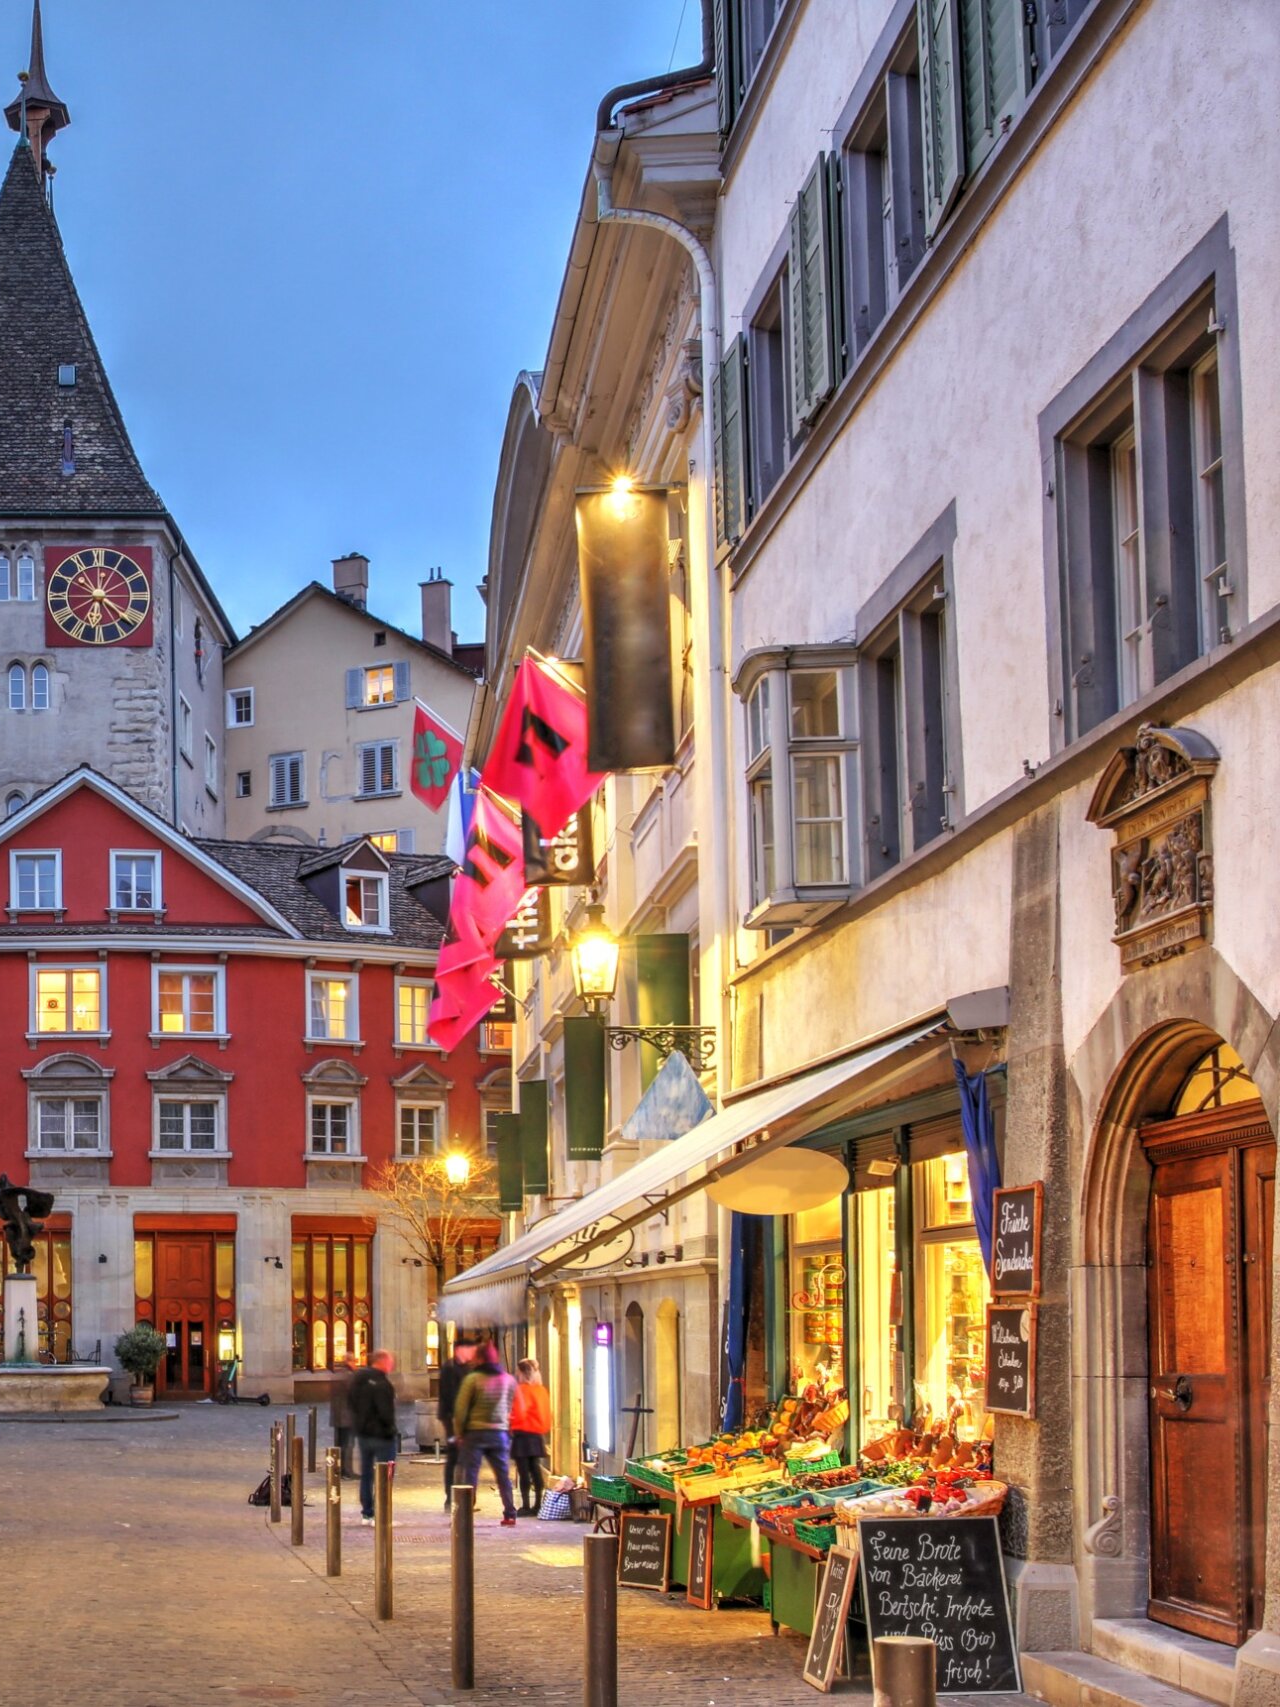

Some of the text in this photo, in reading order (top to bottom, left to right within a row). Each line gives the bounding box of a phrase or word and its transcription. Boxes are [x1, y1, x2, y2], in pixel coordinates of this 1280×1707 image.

[70, 554, 87, 572] XI
[92, 549, 105, 566] XII
[54, 570, 72, 583] X
[126, 571, 143, 582] II
[130, 591, 149, 600] III
[70, 620, 86, 639] VII
[114, 622, 127, 637] V
[870, 1530, 962, 1562] Feine Brote
[869, 1566, 891, 1585] von
[899, 1563, 963, 1591] Bäckerei
[944, 1595, 995, 1621] Imholz
[961, 1628, 996, 1652] (Bio)
[943, 1654, 992, 1688] frisch!
